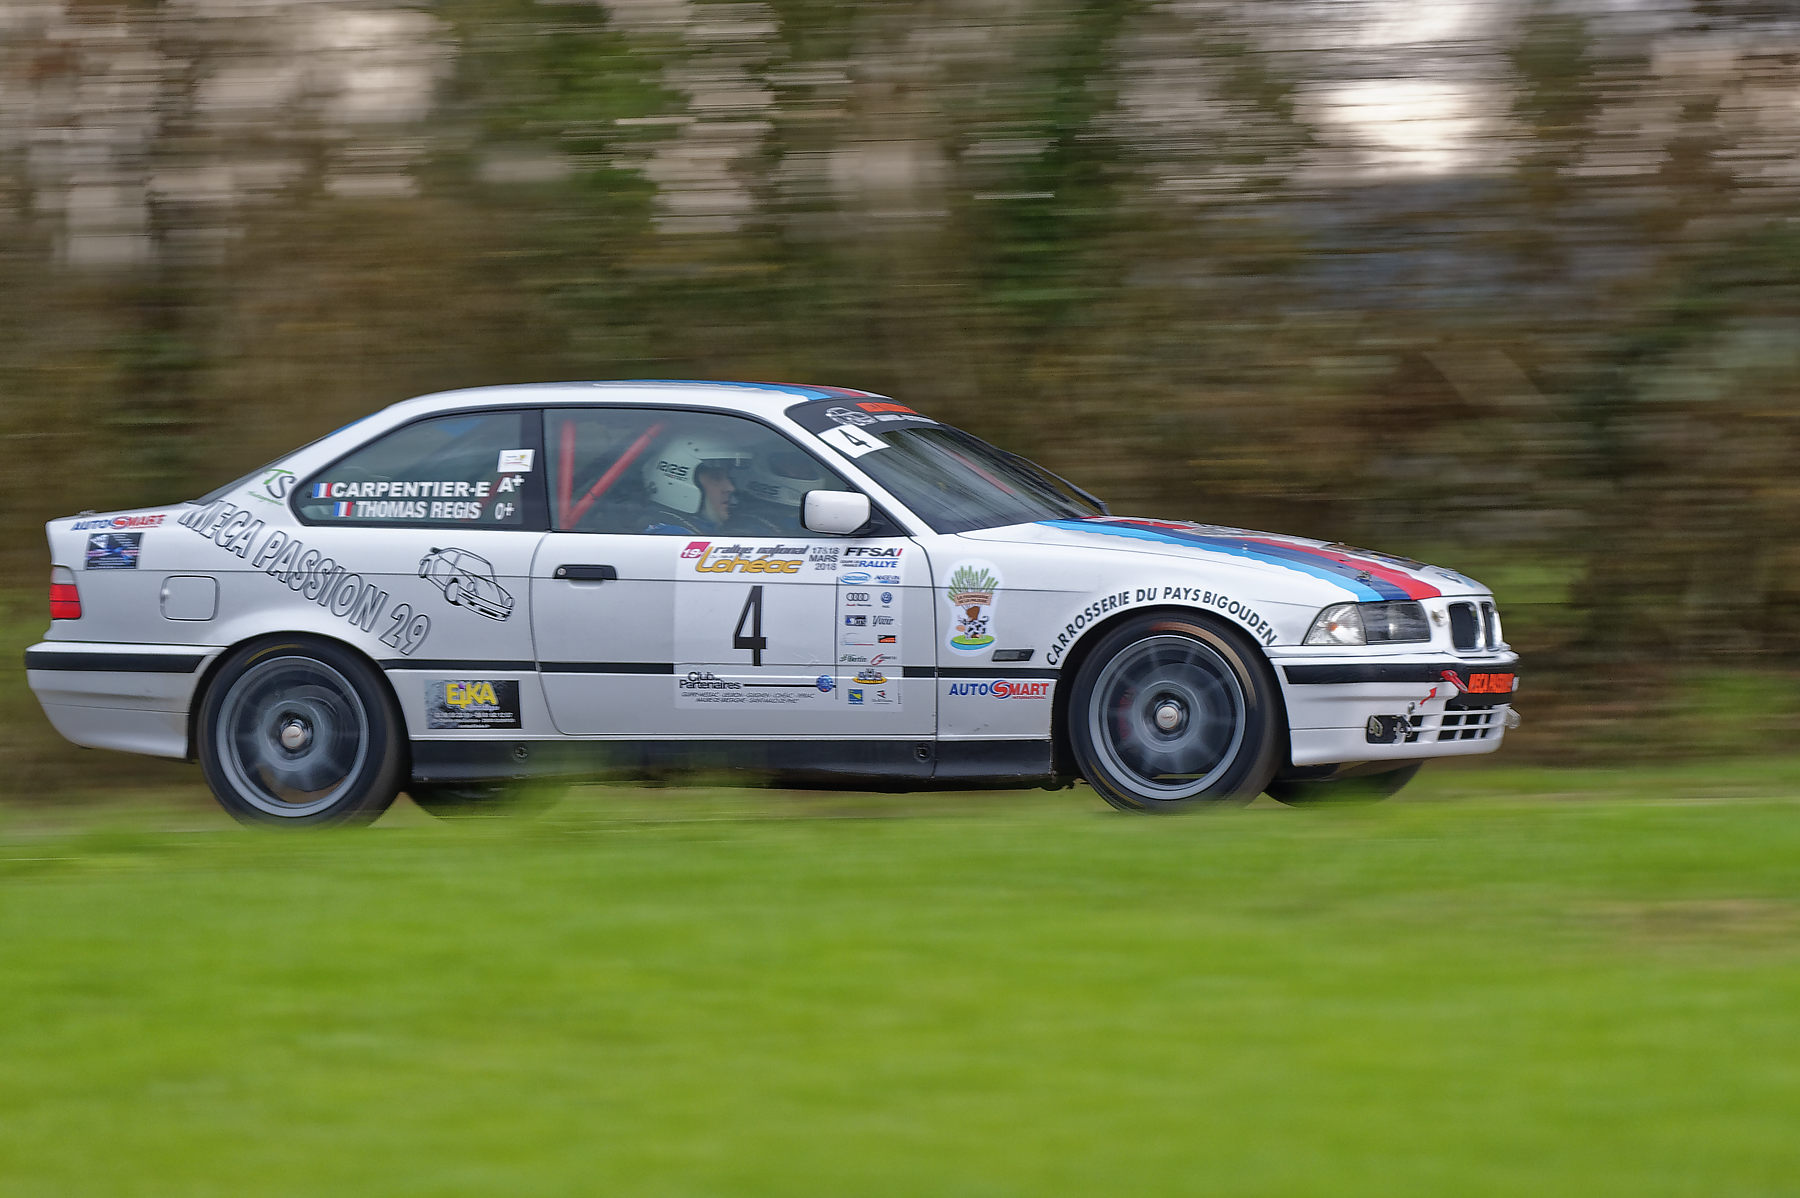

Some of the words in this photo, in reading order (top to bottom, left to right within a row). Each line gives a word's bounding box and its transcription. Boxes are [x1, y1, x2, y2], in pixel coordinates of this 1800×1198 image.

[837, 428, 873, 449] 4
[355, 500, 427, 519] THOMAS
[429, 501, 483, 520] REGIS
[695, 546, 803, 574] Lohéac
[808, 554, 838, 563] MARS
[844, 547, 896, 557] FFSA
[814, 562, 837, 571] 2018
[859, 560, 898, 568] RALLYE
[252, 530, 390, 633] PASSION
[378, 603, 432, 656] 29
[732, 585, 768, 667] 4
[1045, 590, 1130, 666] CARROSSERIE
[1136, 588, 1158, 602] DU
[1163, 586, 1201, 602] PAYS
[1202, 590, 1278, 646] BIGOUDEN
[679, 680, 742, 690] Partenaires
